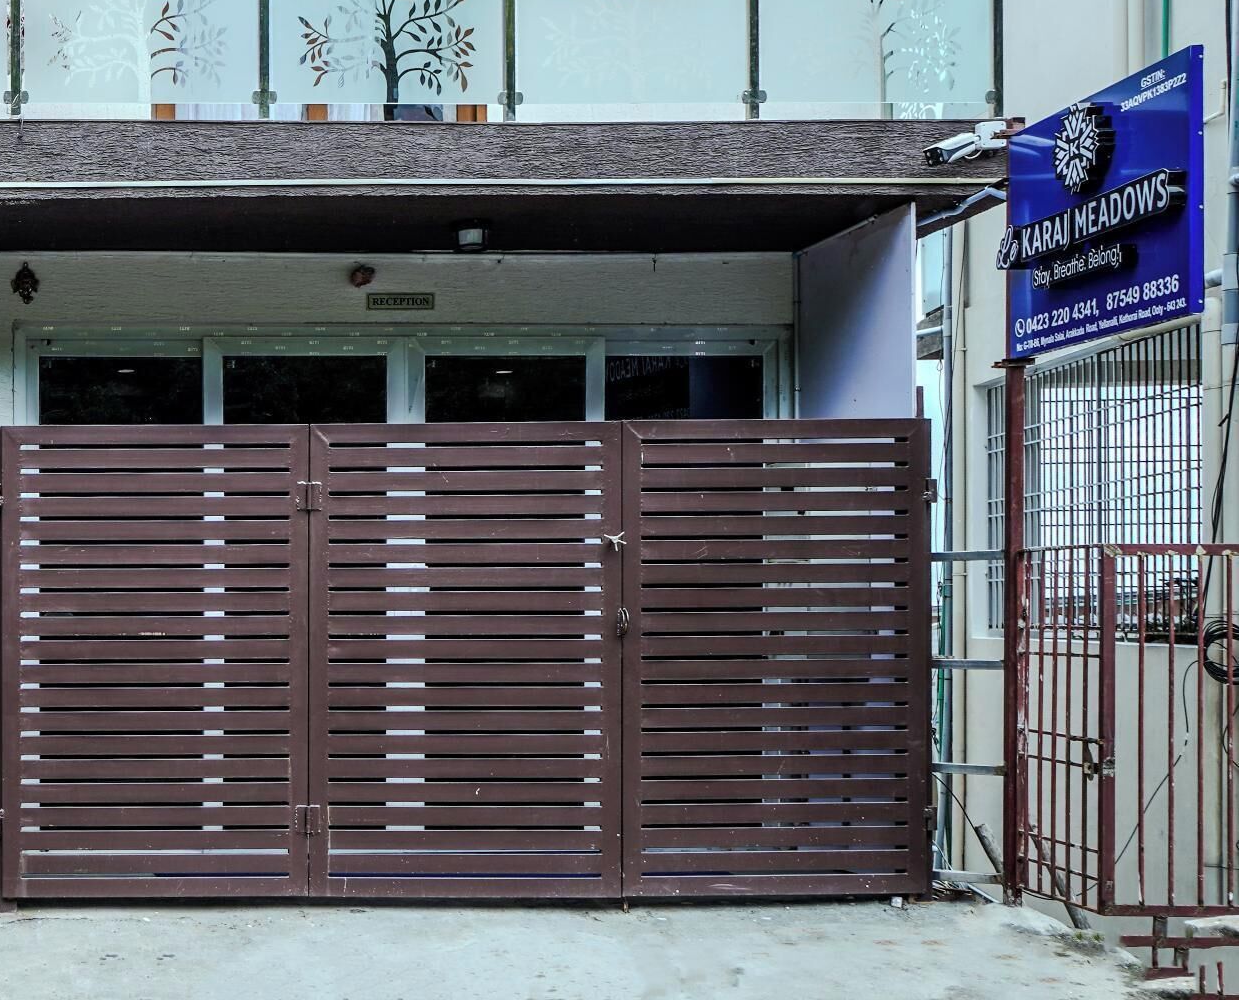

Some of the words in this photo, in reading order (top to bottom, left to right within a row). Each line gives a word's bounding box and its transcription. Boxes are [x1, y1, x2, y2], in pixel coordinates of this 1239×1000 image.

[1141, 69, 1165, 88] GSTIN:
[996, 225, 1018, 269] Le
[1022, 213, 1068, 258] KARAJ
[1074, 173, 1167, 239] MEADOWS
[1033, 267, 1052, 287] Stay.
[1053, 257, 1086, 280] Breathe.
[1088, 248, 1119, 269] Belong.
[372, 297, 430, 306] RECEPTION
[1026, 313, 1049, 334] 0423
[1051, 307, 1070, 327] 220
[1072, 298, 1099, 320] 4341,
[1106, 285, 1140, 310] 87549
[1143, 274, 1179, 300] 88336
